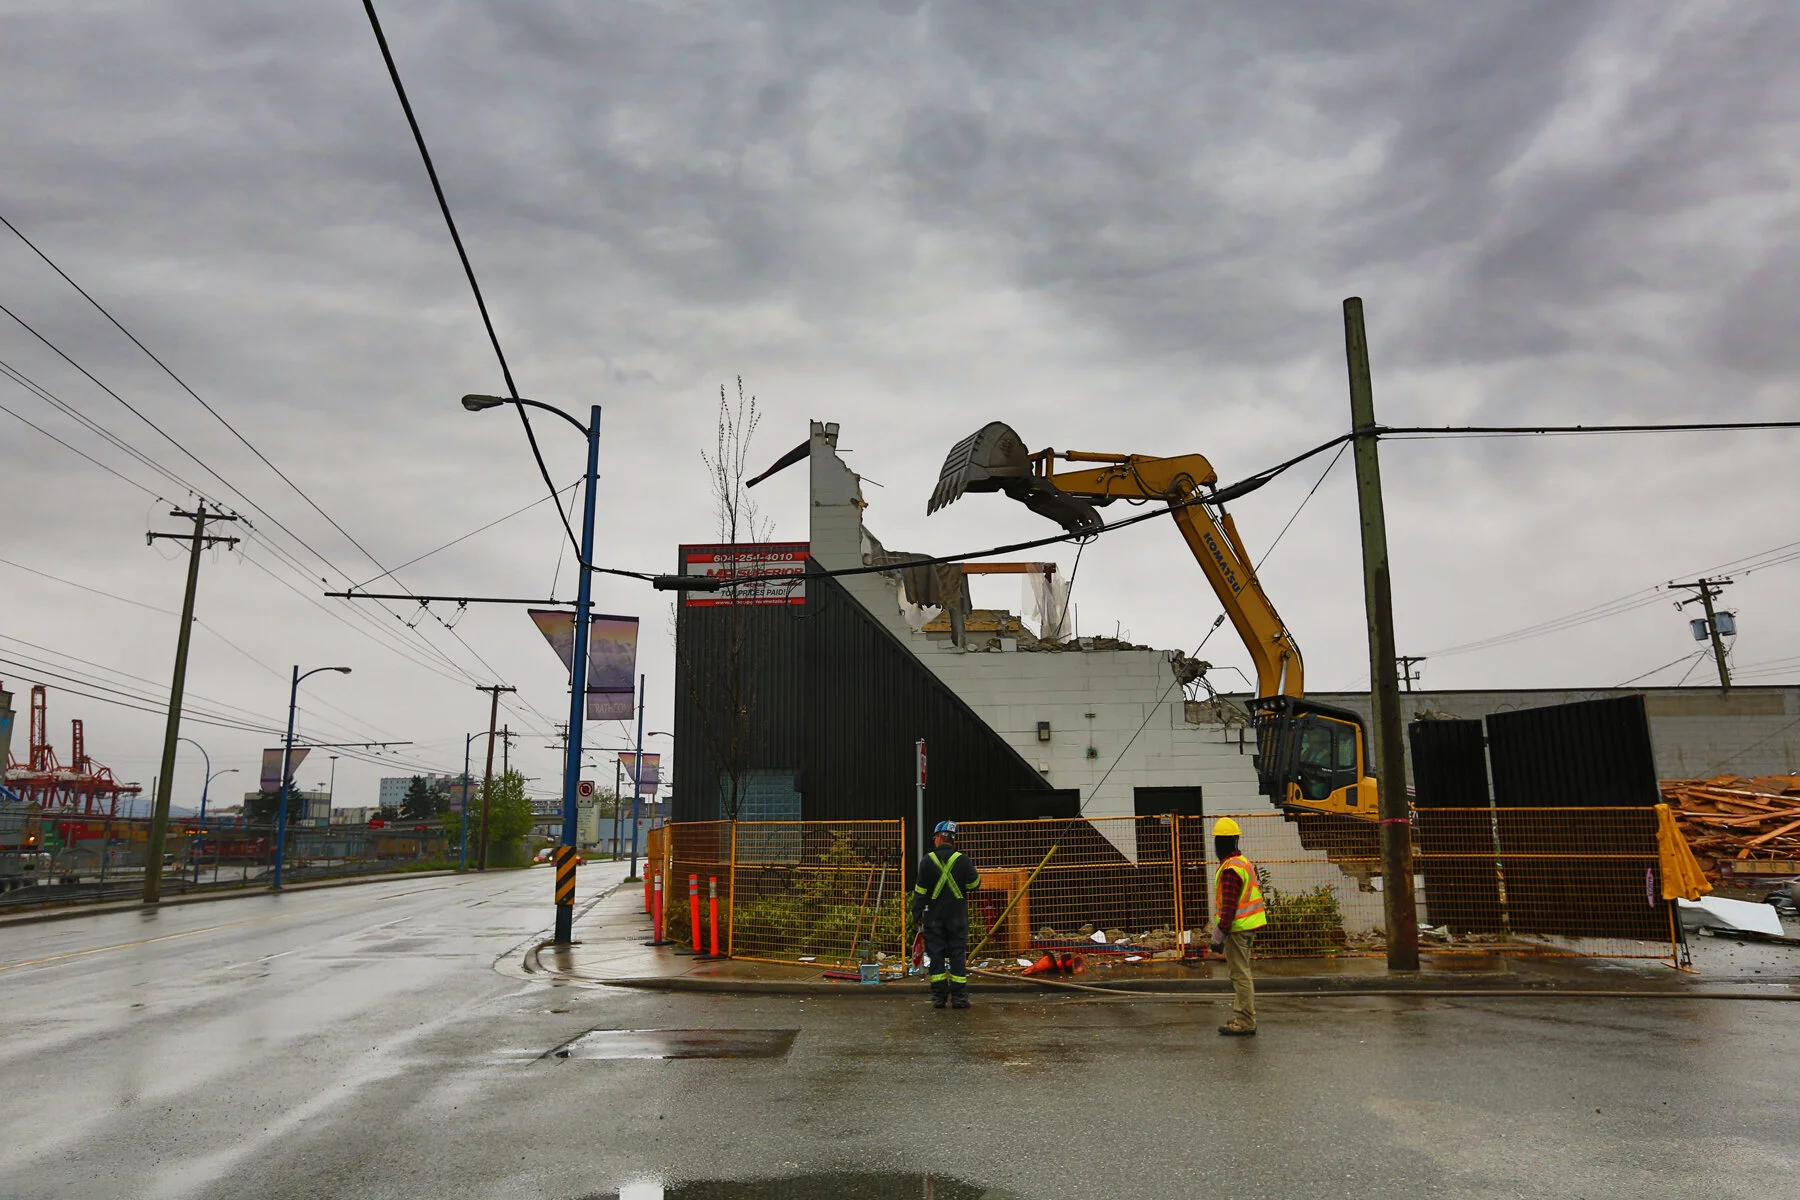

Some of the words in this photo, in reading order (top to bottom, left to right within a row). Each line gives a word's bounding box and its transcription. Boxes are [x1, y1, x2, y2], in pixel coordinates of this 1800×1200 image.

[713, 553, 793, 563] 604-254-4010
[1203, 532, 1240, 593] KOMATSU
[766, 588, 786, 596] PAID!
